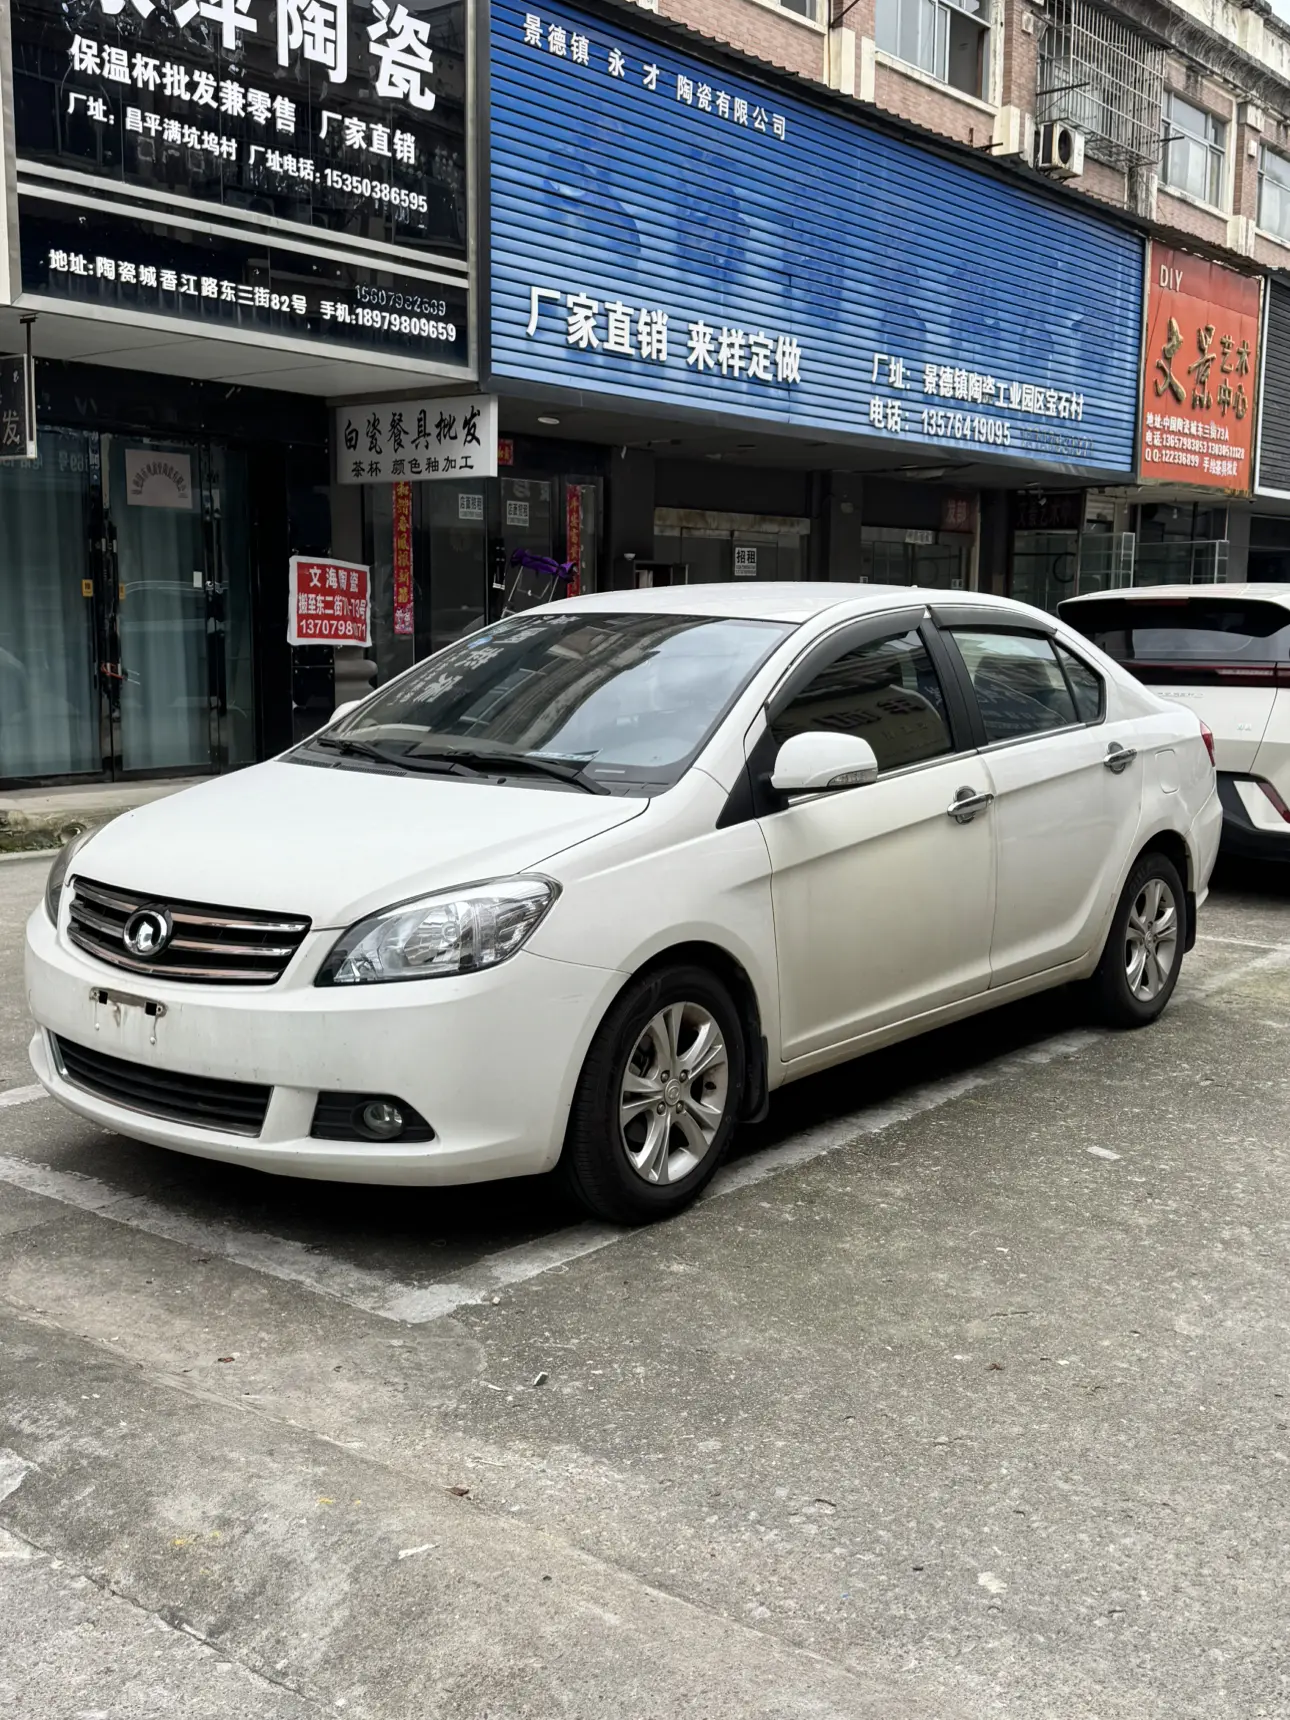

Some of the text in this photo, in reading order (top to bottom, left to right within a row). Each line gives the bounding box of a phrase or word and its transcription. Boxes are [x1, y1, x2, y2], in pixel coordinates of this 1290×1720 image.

[70, 35, 296, 132] 保温杯批发兼零售
[523, 13, 786, 140] 景德镇 永 才 陶瓷有限公司
[319, 110, 416, 164] 厂家直销
[1160, 264, 1183, 291] DIY
[526, 286, 802, 383] 厂家直销 来样定做
[344, 405, 481, 455] 白瓷餐具批发
[351, 455, 475, 478] 茶杯 颜色釉加工
[736, 549, 756, 564] 招租
